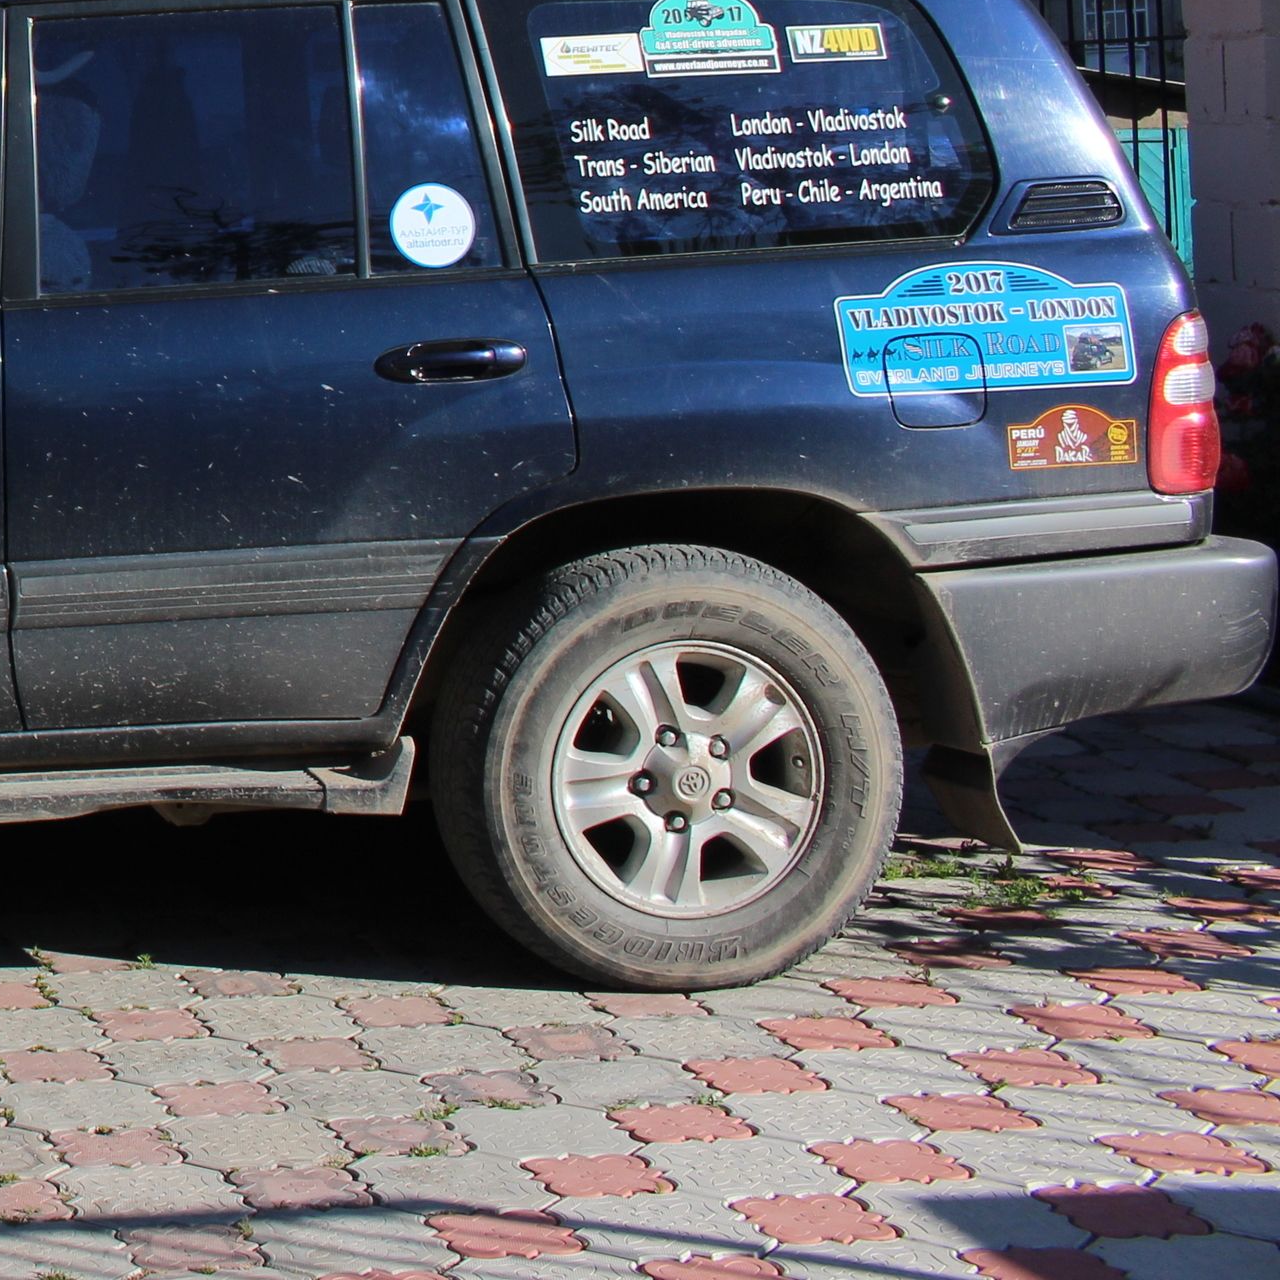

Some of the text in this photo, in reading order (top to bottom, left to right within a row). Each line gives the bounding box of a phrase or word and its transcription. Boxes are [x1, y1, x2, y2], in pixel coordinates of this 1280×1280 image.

[662, 6, 741, 24] 20 17
[655, 38, 762, 50] 4x4 self-drive adventure
[665, 30, 705, 38] Vladivostok
[715, 29, 747, 38] Magadan
[794, 28, 877, 54] NZ4WD
[654, 58, 769, 72] www.overlandjourneys.co.nz
[570, 116, 651, 143] Silk Road
[730, 111, 793, 137] London
[807, 105, 907, 133] Vladivostok
[574, 155, 625, 177] Trans
[643, 150, 715, 175] Siberian
[735, 143, 834, 171] Vladivostok
[849, 140, 911, 167] London
[580, 186, 708, 213] South America
[741, 182, 782, 206] Peru
[798, 178, 841, 204] Chile
[859, 176, 943, 207] Argentina
[946, 271, 1004, 294] 2017
[847, 301, 1006, 330] VLADIVOSTOK
[1028, 296, 1116, 322] LONDON
[856, 360, 1065, 386] OVERLAND JOURNEYS
[1012, 425, 1045, 439] PERÚ
[1055, 445, 1093, 463] DAKAR
[620, 599, 841, 688] DUELER
[512, 771, 742, 965] BRIDGESTONE
